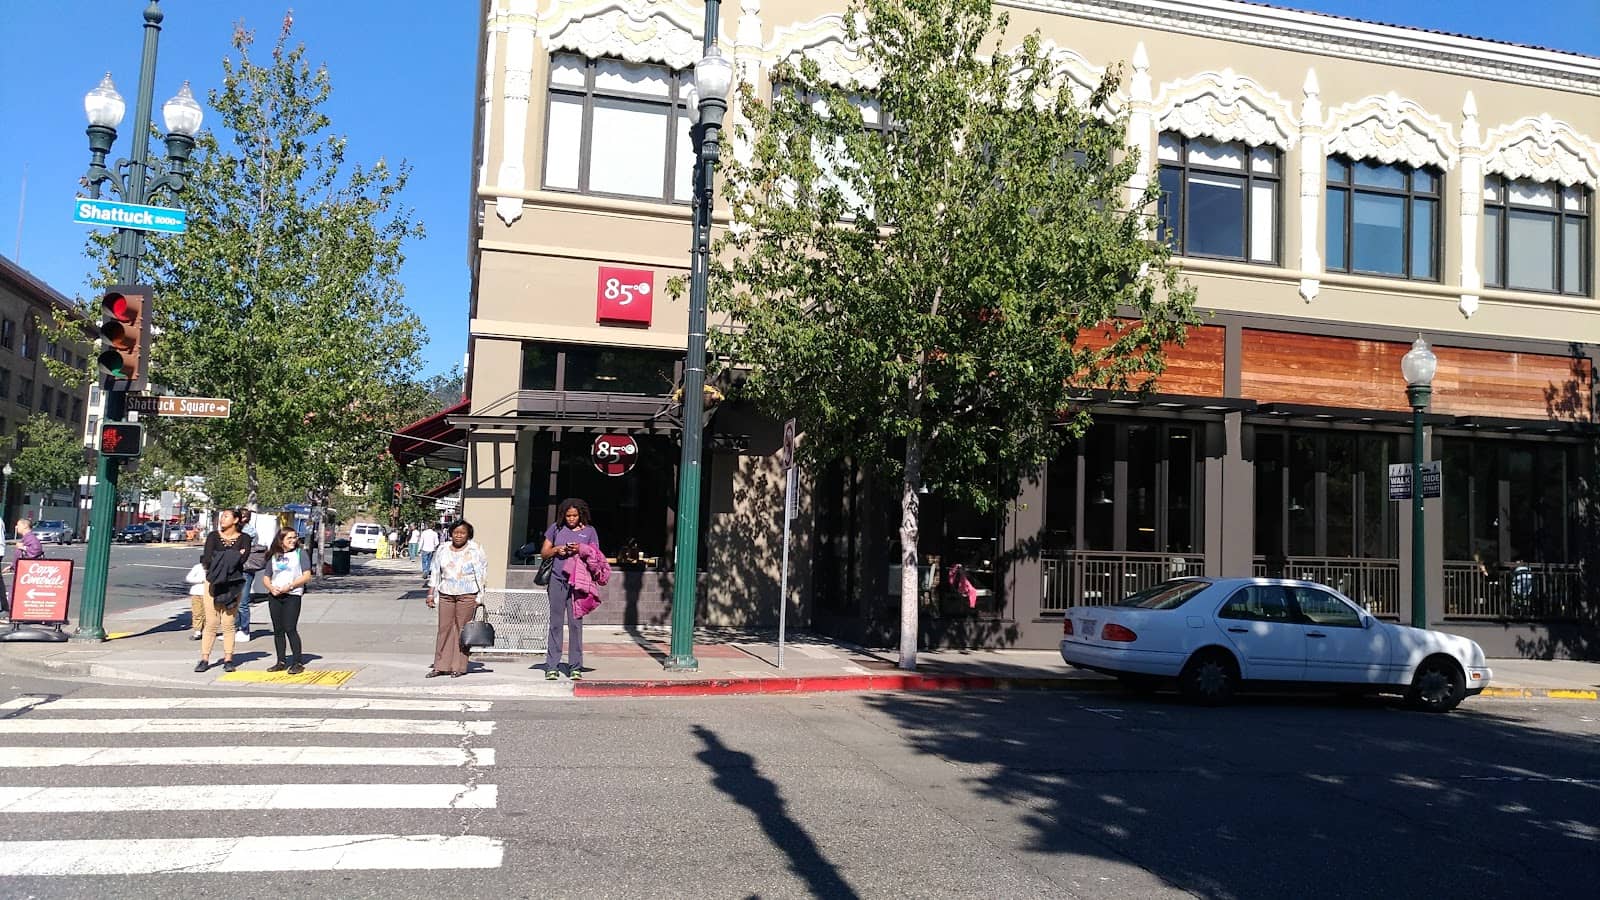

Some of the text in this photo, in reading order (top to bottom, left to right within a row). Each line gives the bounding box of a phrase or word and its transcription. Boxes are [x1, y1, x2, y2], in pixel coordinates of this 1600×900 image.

[79, 203, 153, 225] Shattuck
[128, 397, 216, 414] Shattuck Square
[1390, 476, 1410, 484] WALK
[29, 563, 60, 577] Copy
